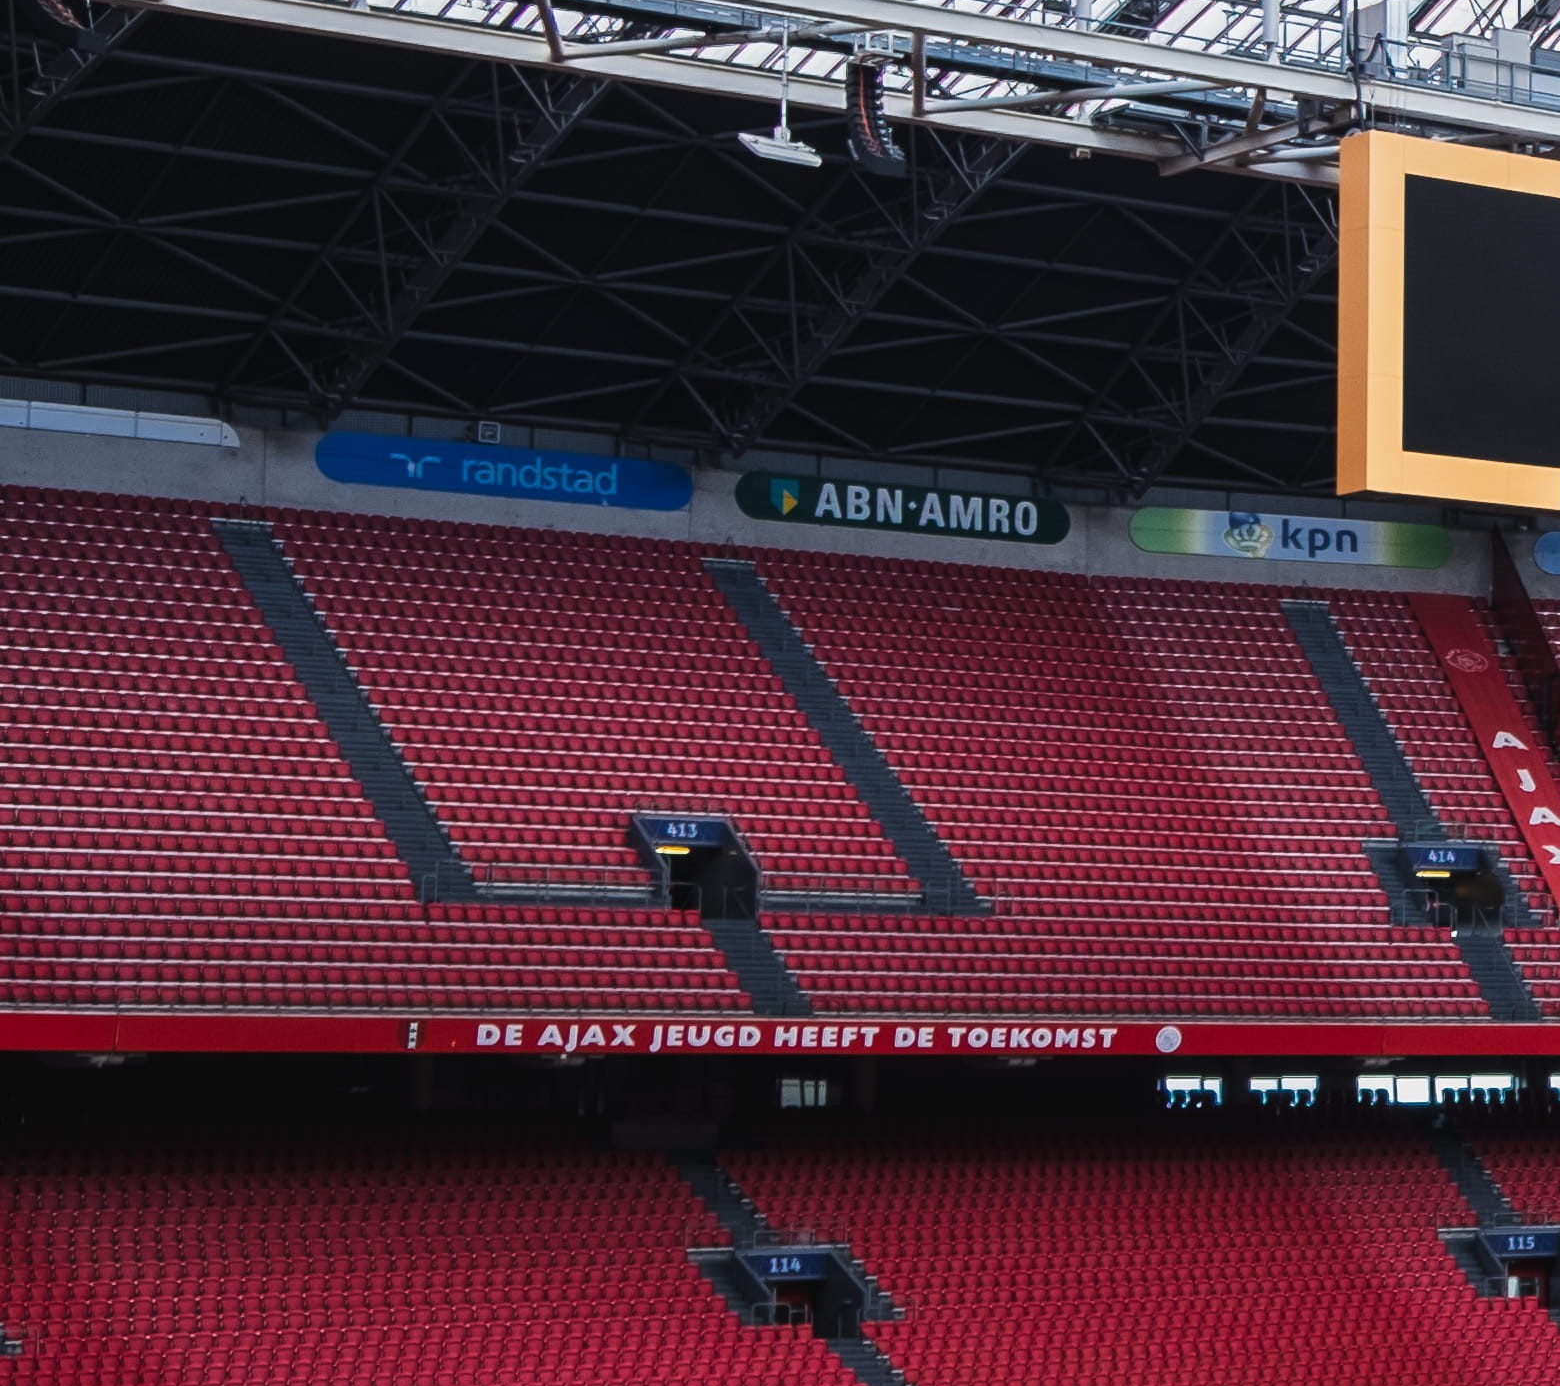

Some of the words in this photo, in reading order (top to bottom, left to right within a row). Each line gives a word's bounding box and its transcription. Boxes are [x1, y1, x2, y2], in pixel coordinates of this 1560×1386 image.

[462, 456, 618, 496] randstad
[1281, 518, 1359, 559] kpn
[666, 823, 697, 838] 413
[1428, 850, 1455, 863] 414
[476, 1024, 524, 1047] DE
[537, 1024, 637, 1053] AJAX
[649, 1025, 761, 1053] JEUGD
[774, 1026, 880, 1048] HEEFT
[893, 1026, 935, 1049] DE
[947, 1027, 1118, 1049] TOEKOMST
[1507, 1236, 1534, 1250] 115
[770, 1258, 801, 1273] 114
